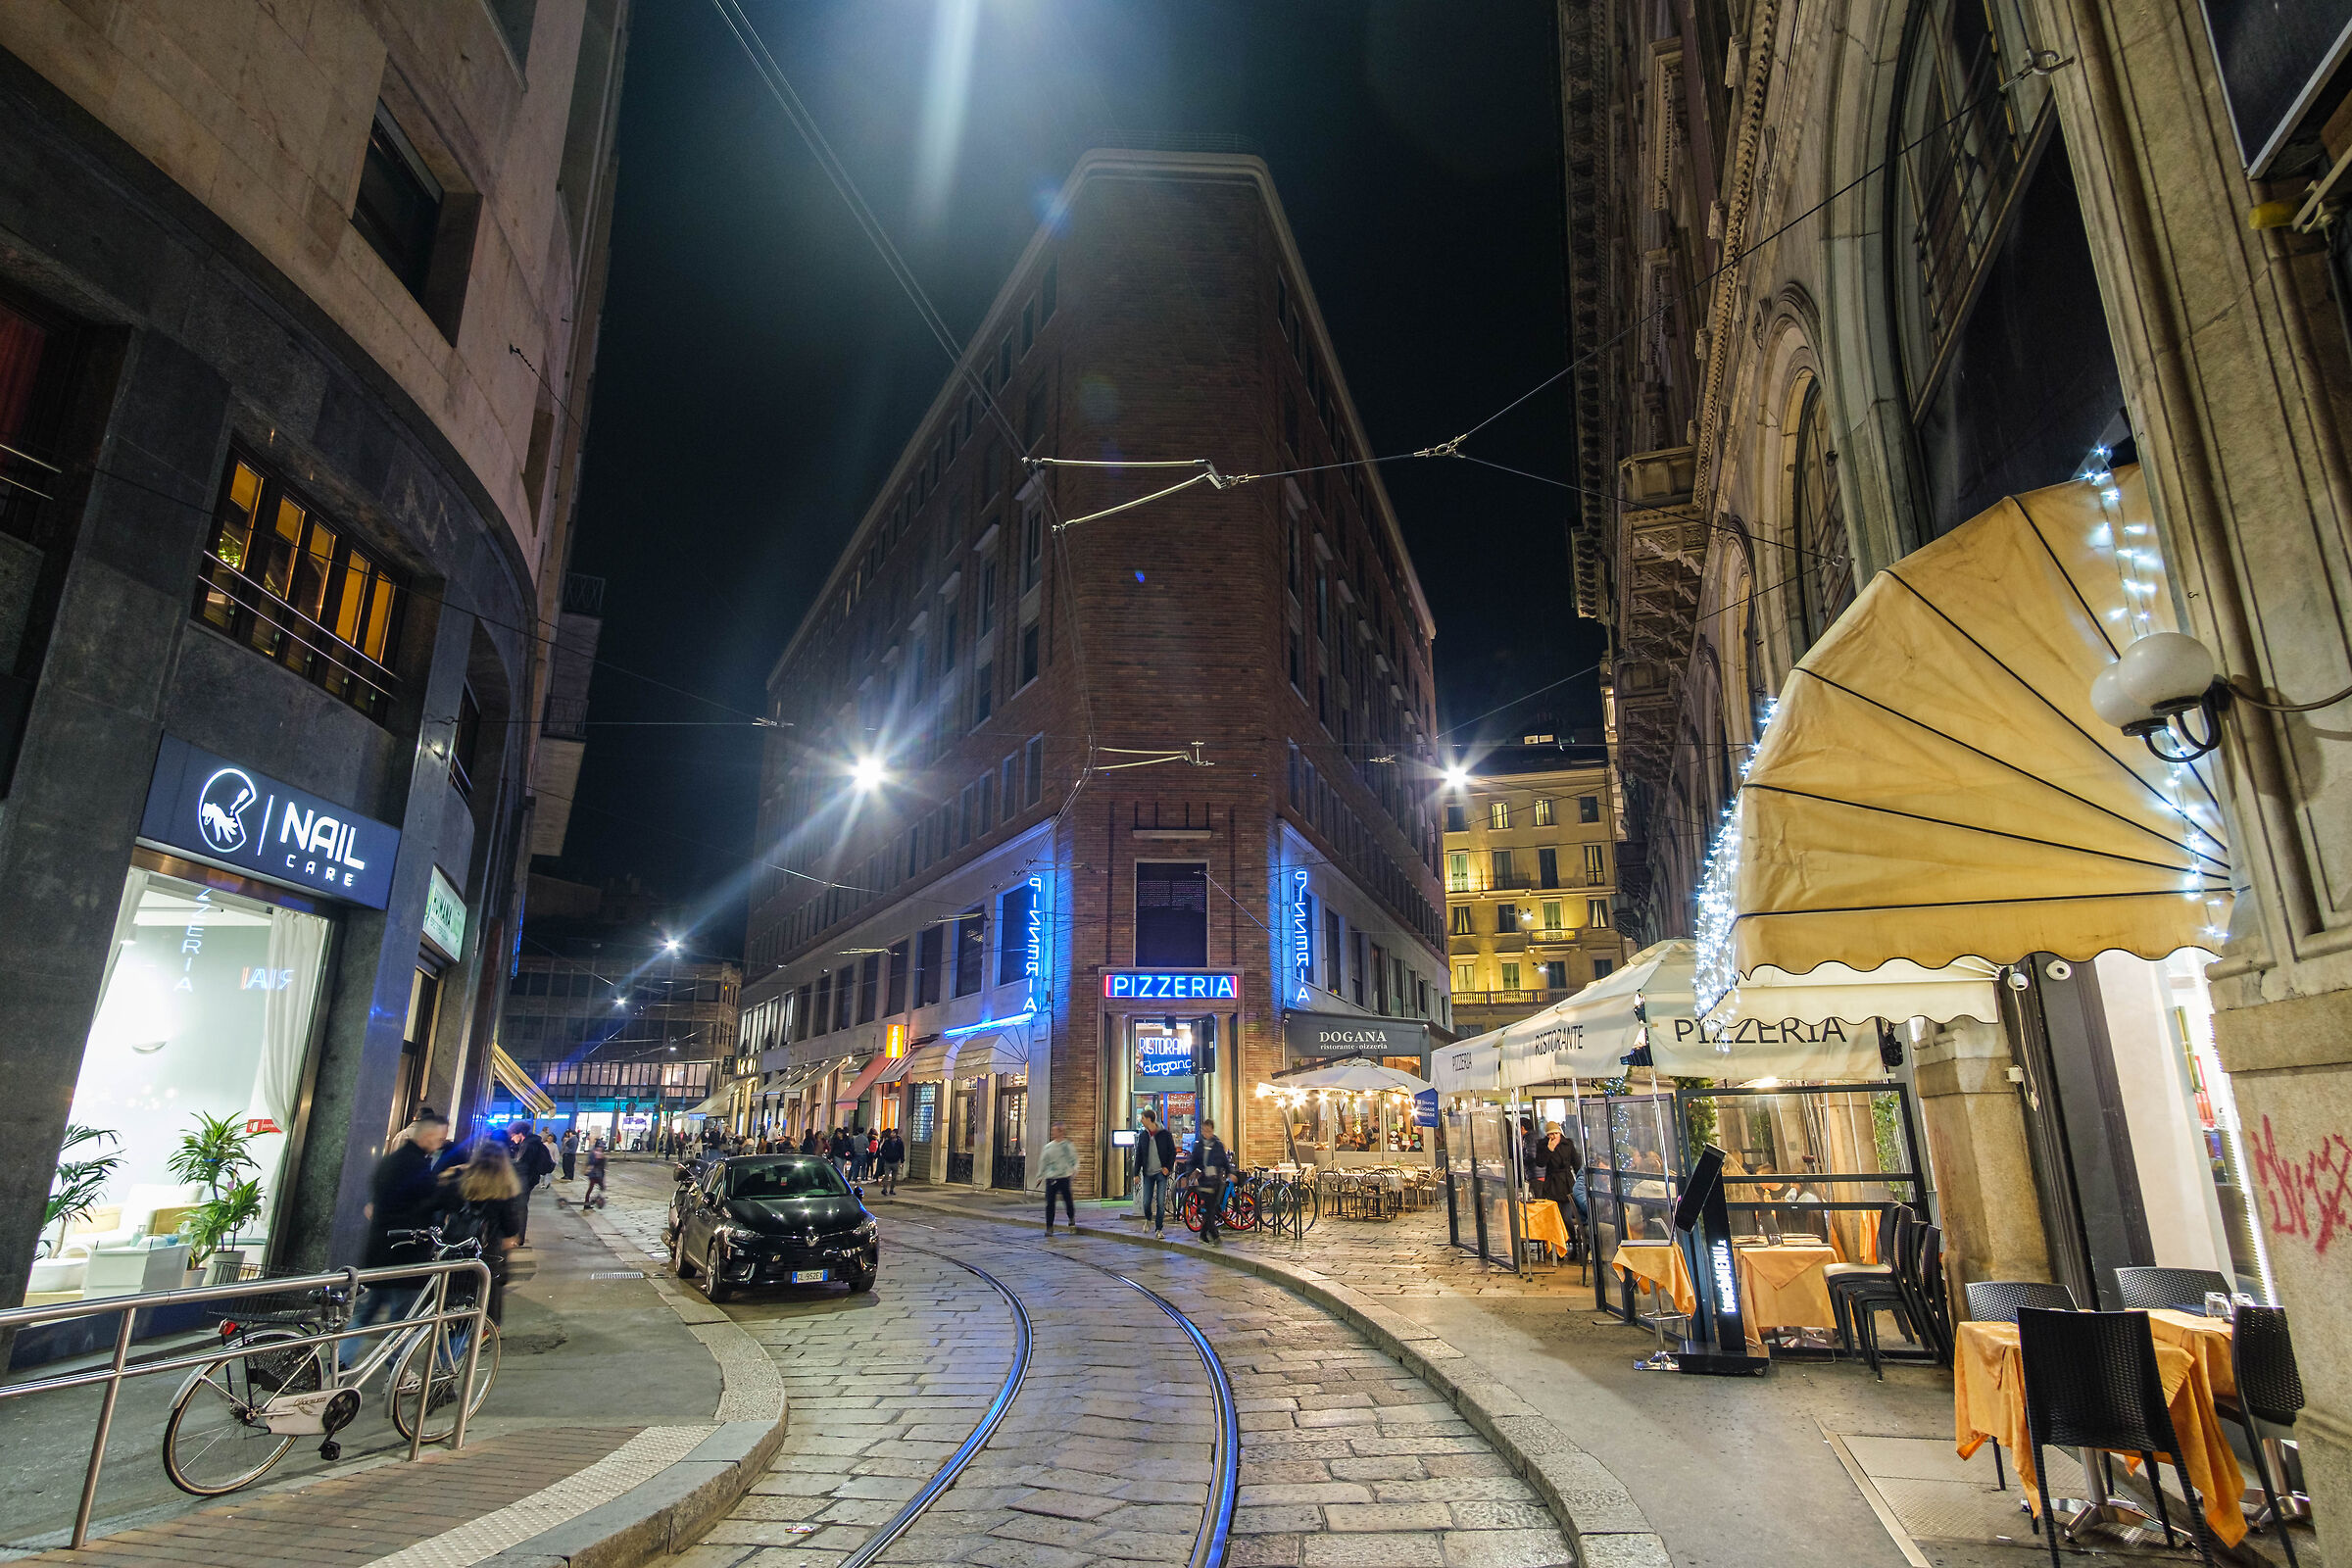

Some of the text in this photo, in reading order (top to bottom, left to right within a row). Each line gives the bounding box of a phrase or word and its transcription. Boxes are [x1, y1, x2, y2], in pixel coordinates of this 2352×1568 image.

[279, 801, 366, 870] NAIL
[285, 854, 354, 887] CARE
[431, 887, 453, 930] HUMANA
[1113, 976, 1234, 998] PIZZERIA
[1319, 1031, 1388, 1043] DOGANA
[1535, 1025, 1584, 1056] RISTORANTE
[1451, 1052, 1473, 1072] PIZZERIA
